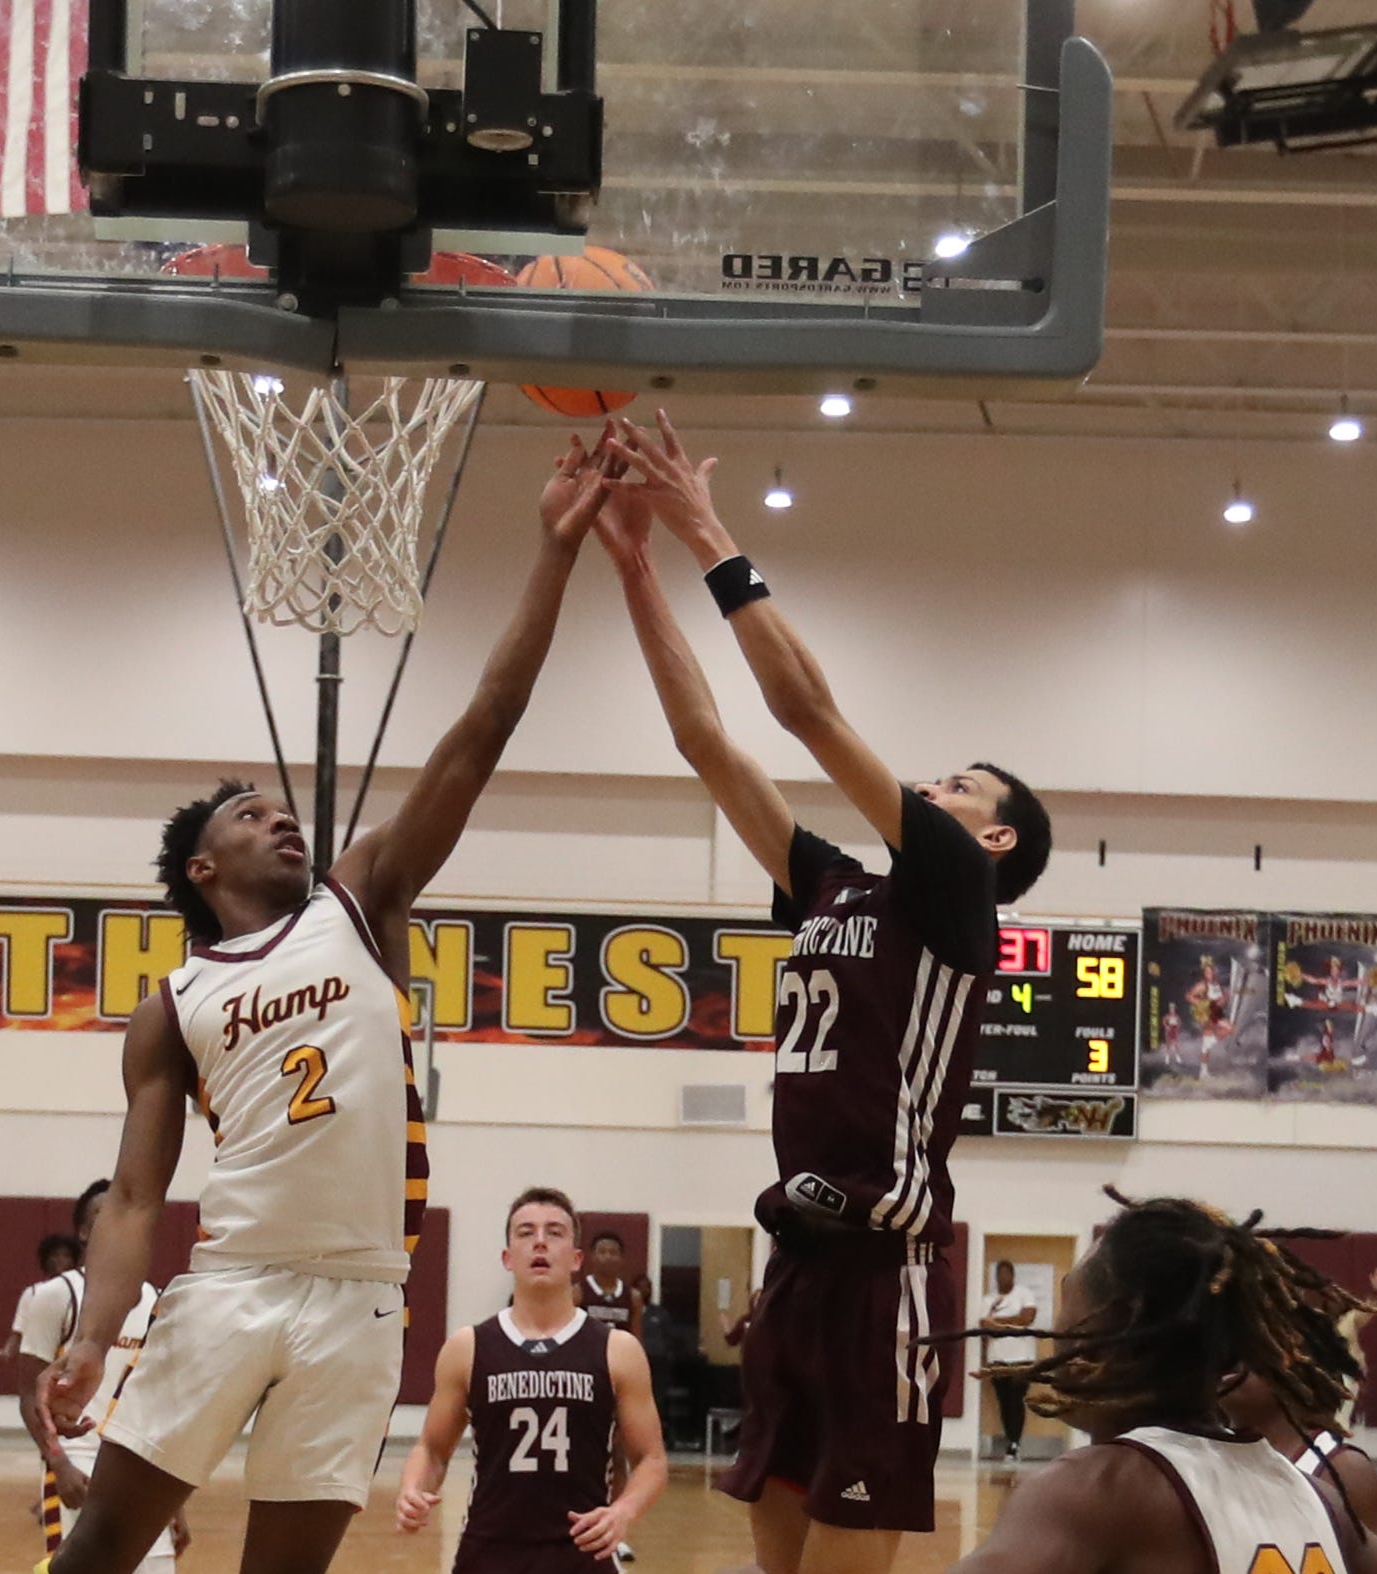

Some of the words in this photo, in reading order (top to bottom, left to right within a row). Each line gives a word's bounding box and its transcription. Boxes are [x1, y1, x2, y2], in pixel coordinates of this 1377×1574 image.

[1068, 933, 1128, 952] HOME
[1158, 912, 1258, 943] PHOENIX
[1076, 956, 1124, 999] 58
[222, 976, 350, 1051] Hamp
[1011, 982, 1033, 1014] 4
[776, 969, 839, 1073] 22
[1075, 1026, 1116, 1039] FOULS
[1087, 1039, 1109, 1073] 3
[280, 1044, 337, 1125] 2
[487, 1370, 594, 1403] BENEDICTINE
[509, 1406, 571, 1472] 24
